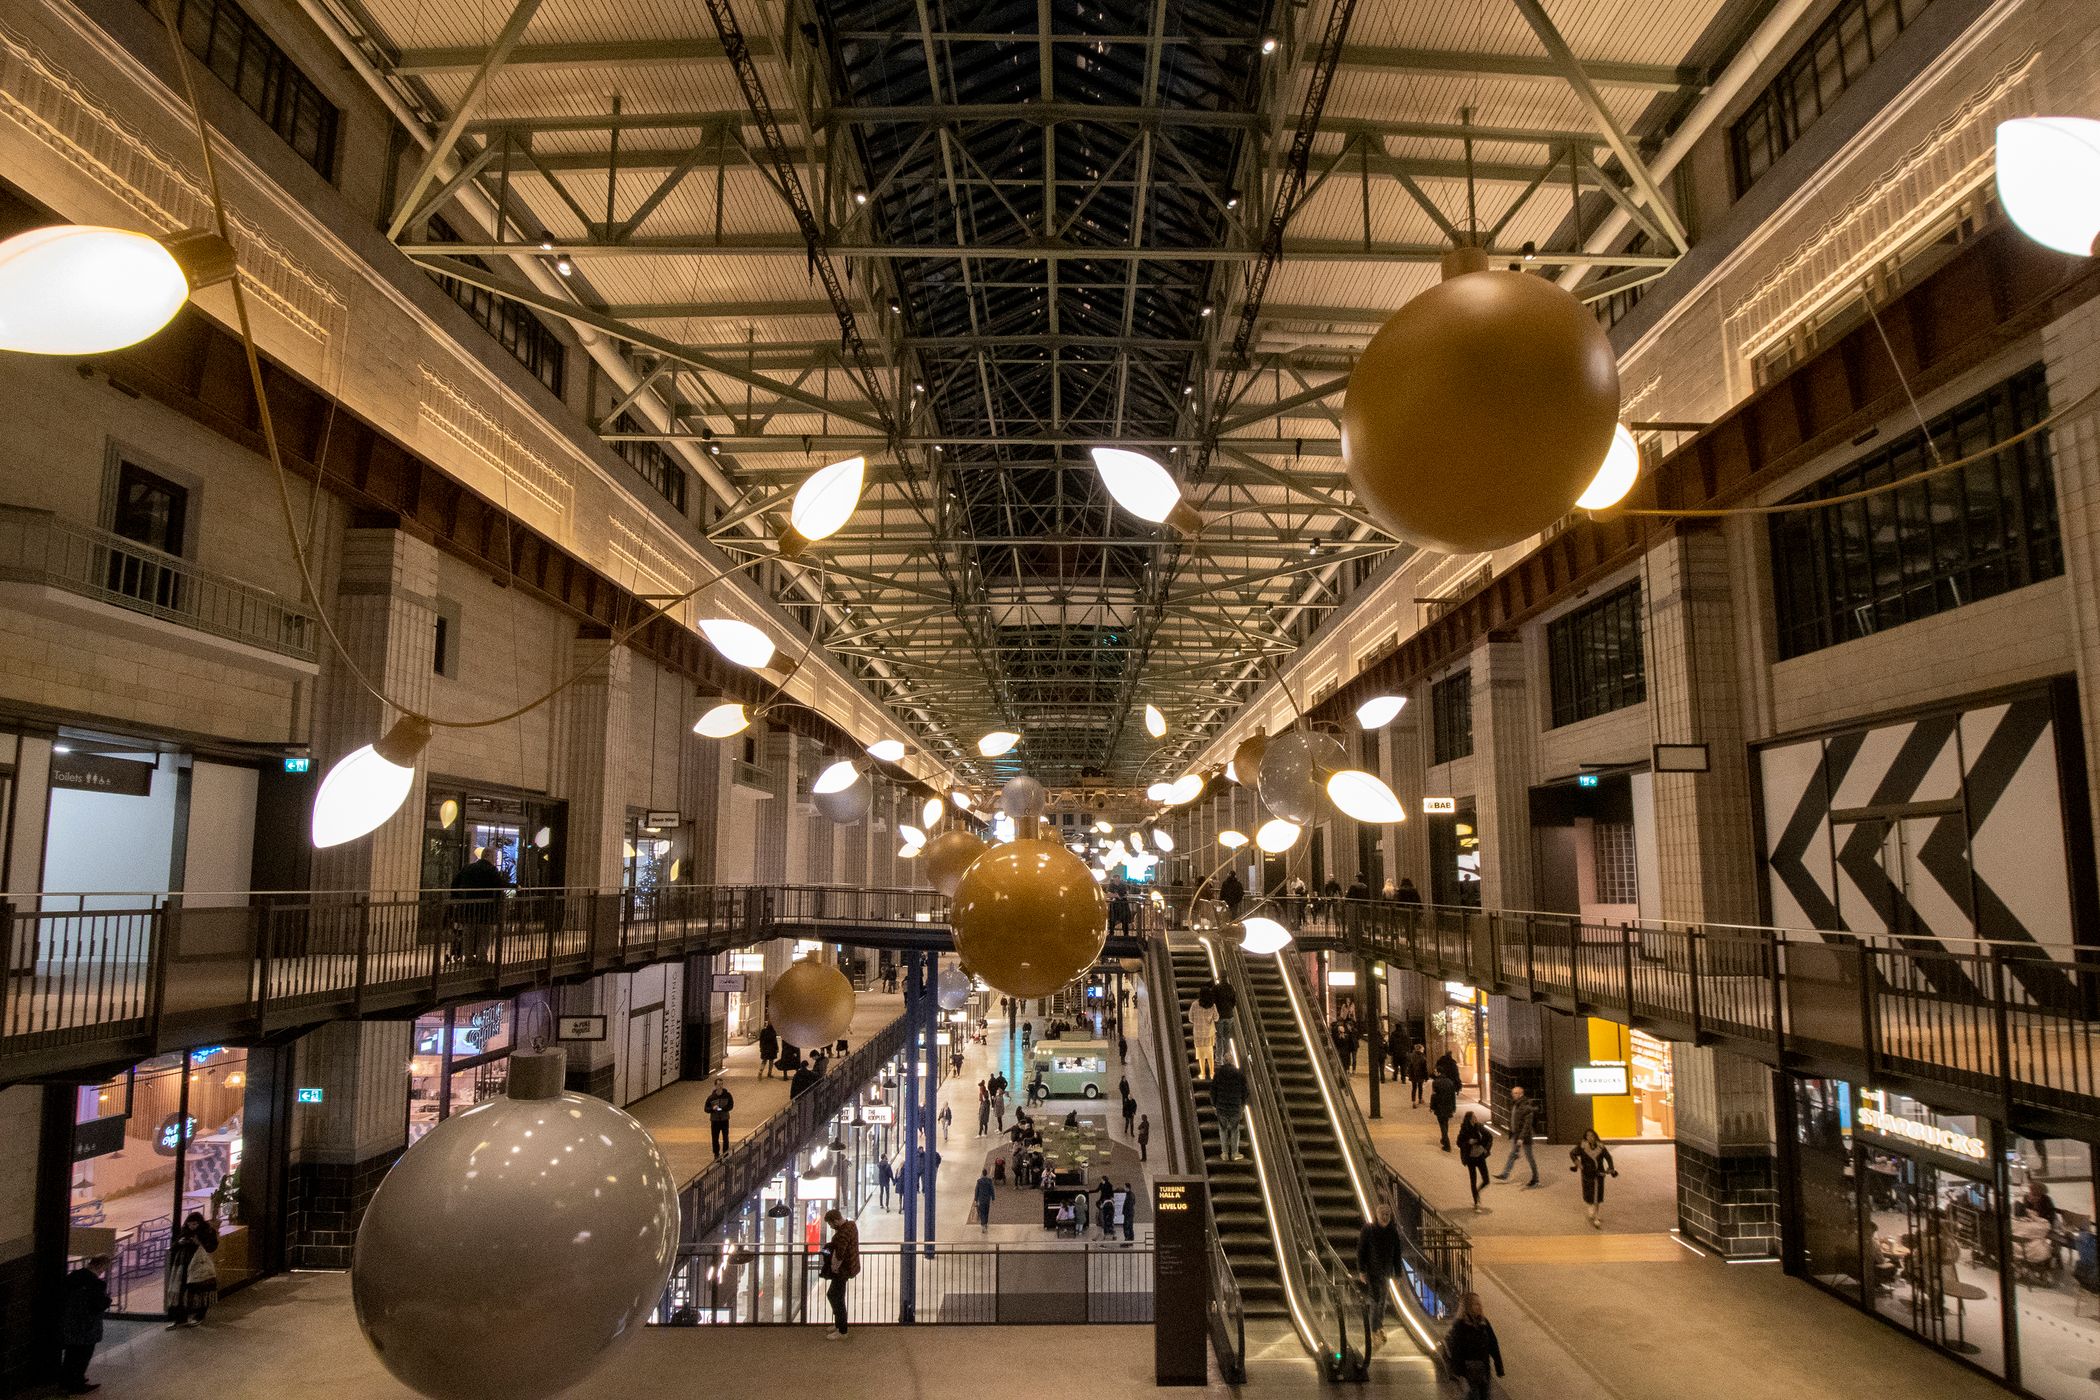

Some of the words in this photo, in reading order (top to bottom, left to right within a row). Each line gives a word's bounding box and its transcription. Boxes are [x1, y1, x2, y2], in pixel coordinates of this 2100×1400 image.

[54, 770, 83, 783] Toilets
[670, 971, 678, 1036] SHOPPING
[662, 1009, 670, 1076] RE-ROUTE
[1858, 1107, 1985, 1158] STARBUCKS
